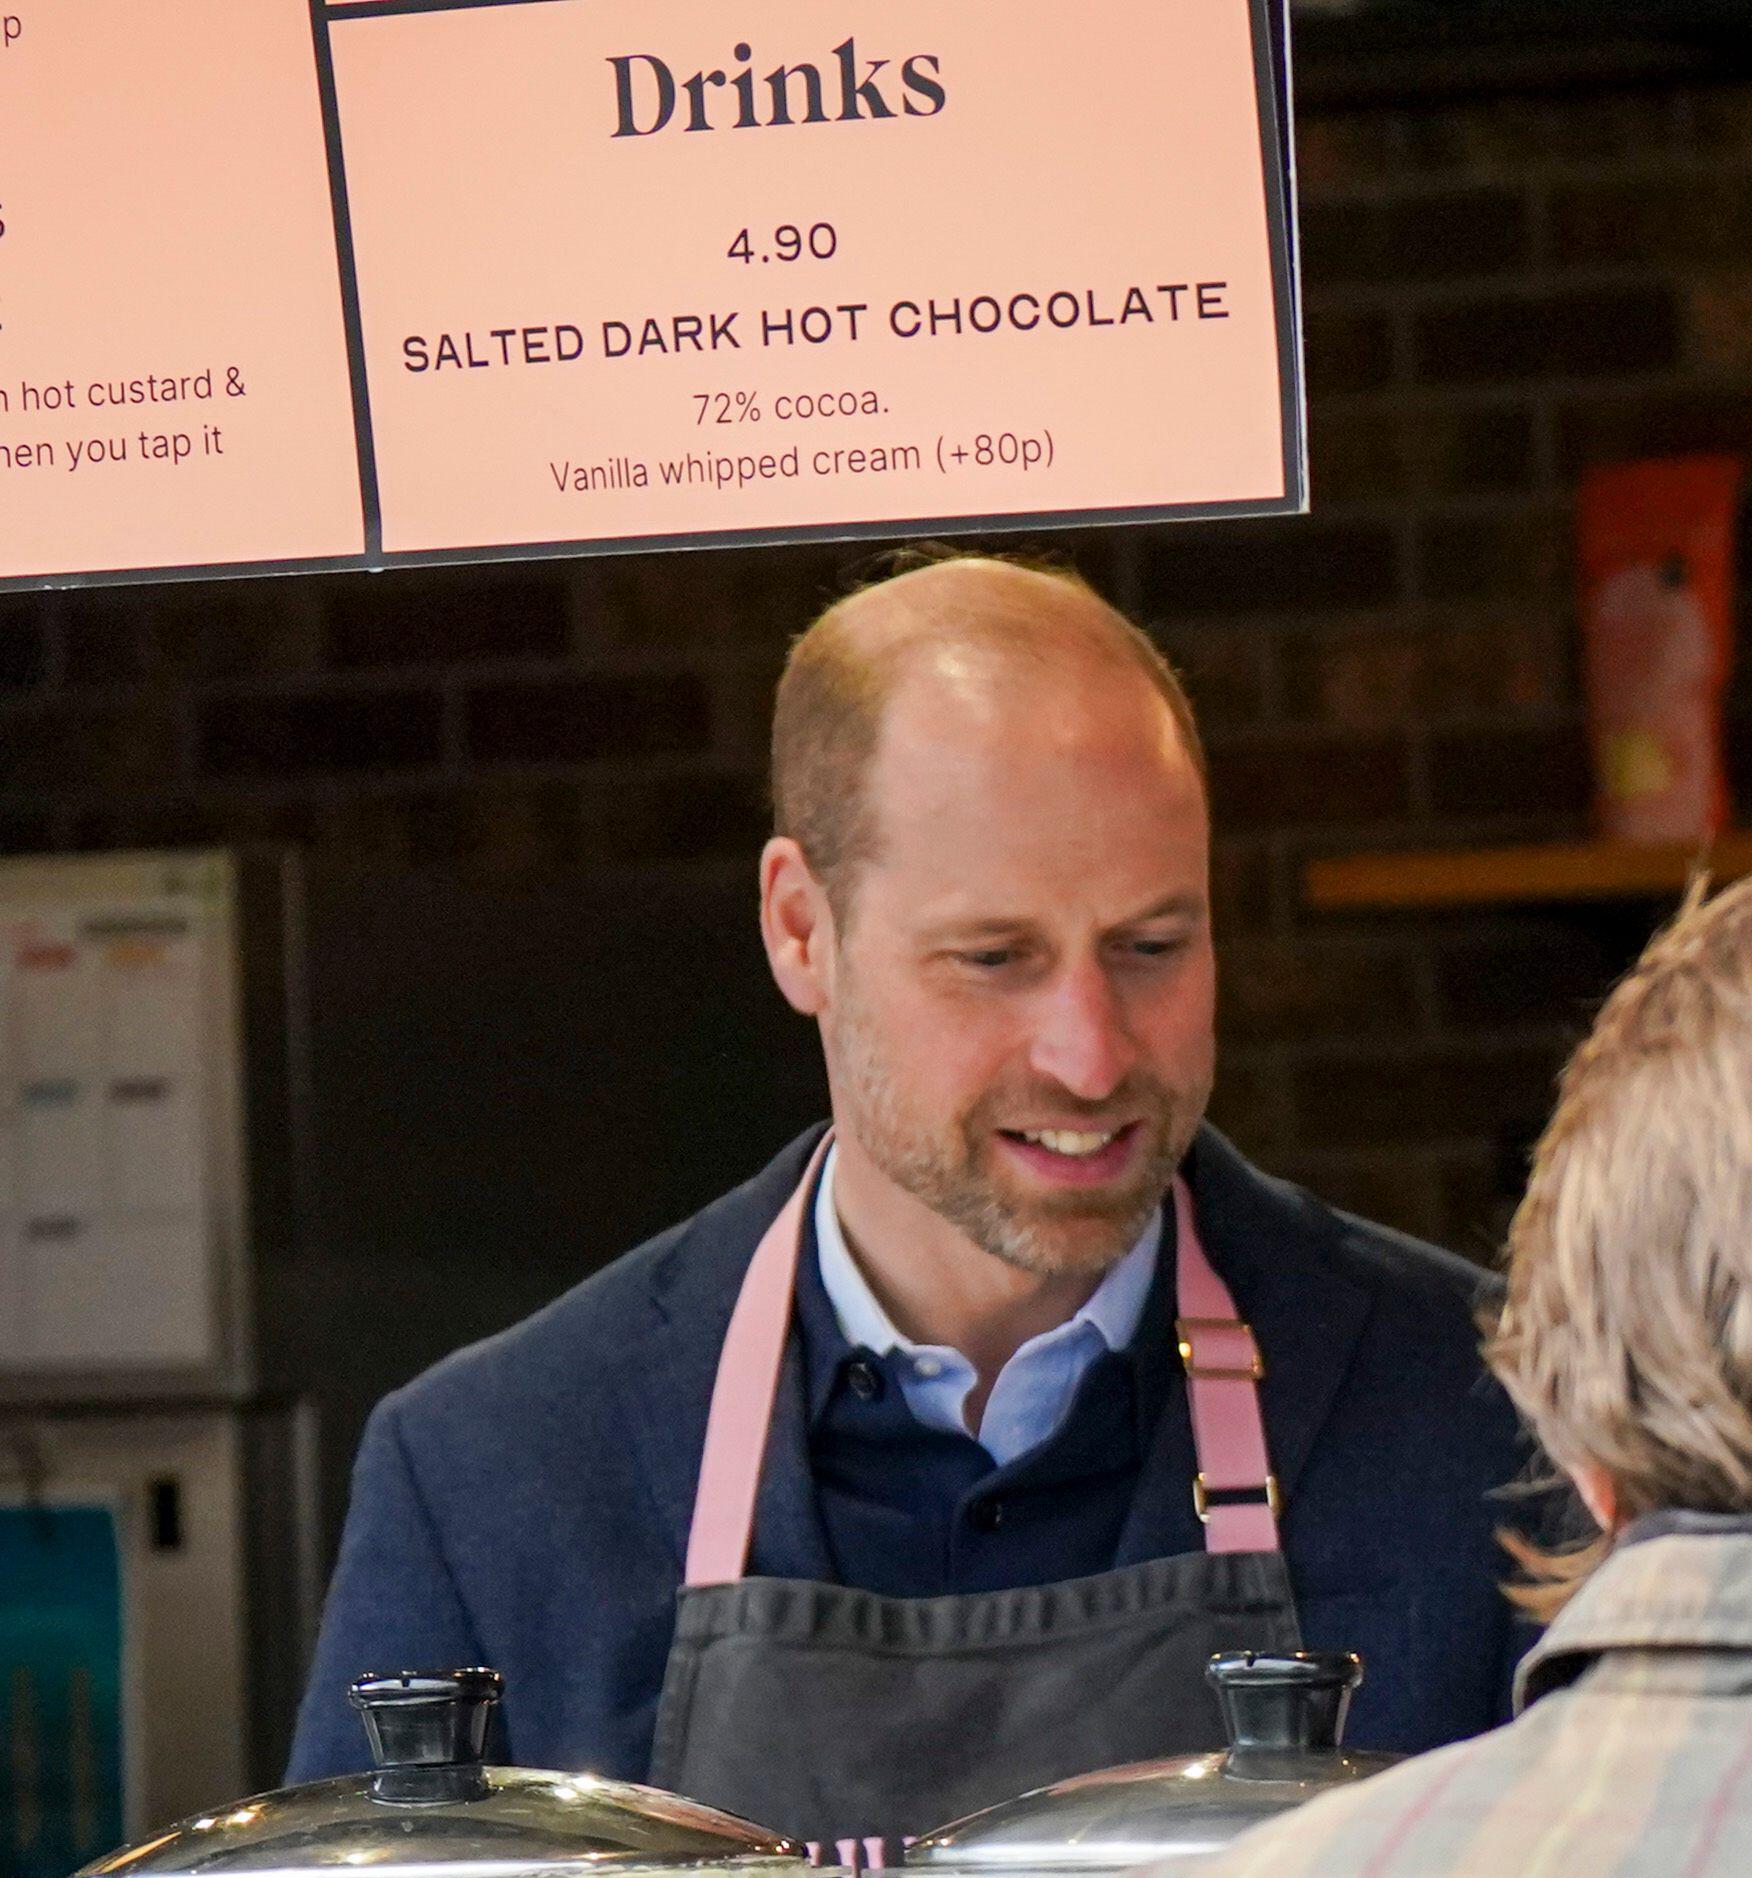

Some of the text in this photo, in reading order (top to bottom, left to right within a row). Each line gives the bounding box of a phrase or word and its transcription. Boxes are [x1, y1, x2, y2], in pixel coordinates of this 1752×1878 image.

[605, 36, 946, 138] Drinks
[727, 222, 838, 264] 4.90
[402, 281, 1230, 372] SALTED DARK HOT CHOCOLATE
[22, 380, 76, 411] hot
[87, 368, 213, 407] custard
[225, 366, 247, 398] &
[692, 390, 889, 426] 72% cocoa.
[65, 438, 127, 473] you
[138, 431, 192, 466] tap
[203, 424, 224, 456] it
[549, 429, 1054, 493] Vanilla whipped cream (+80p)
